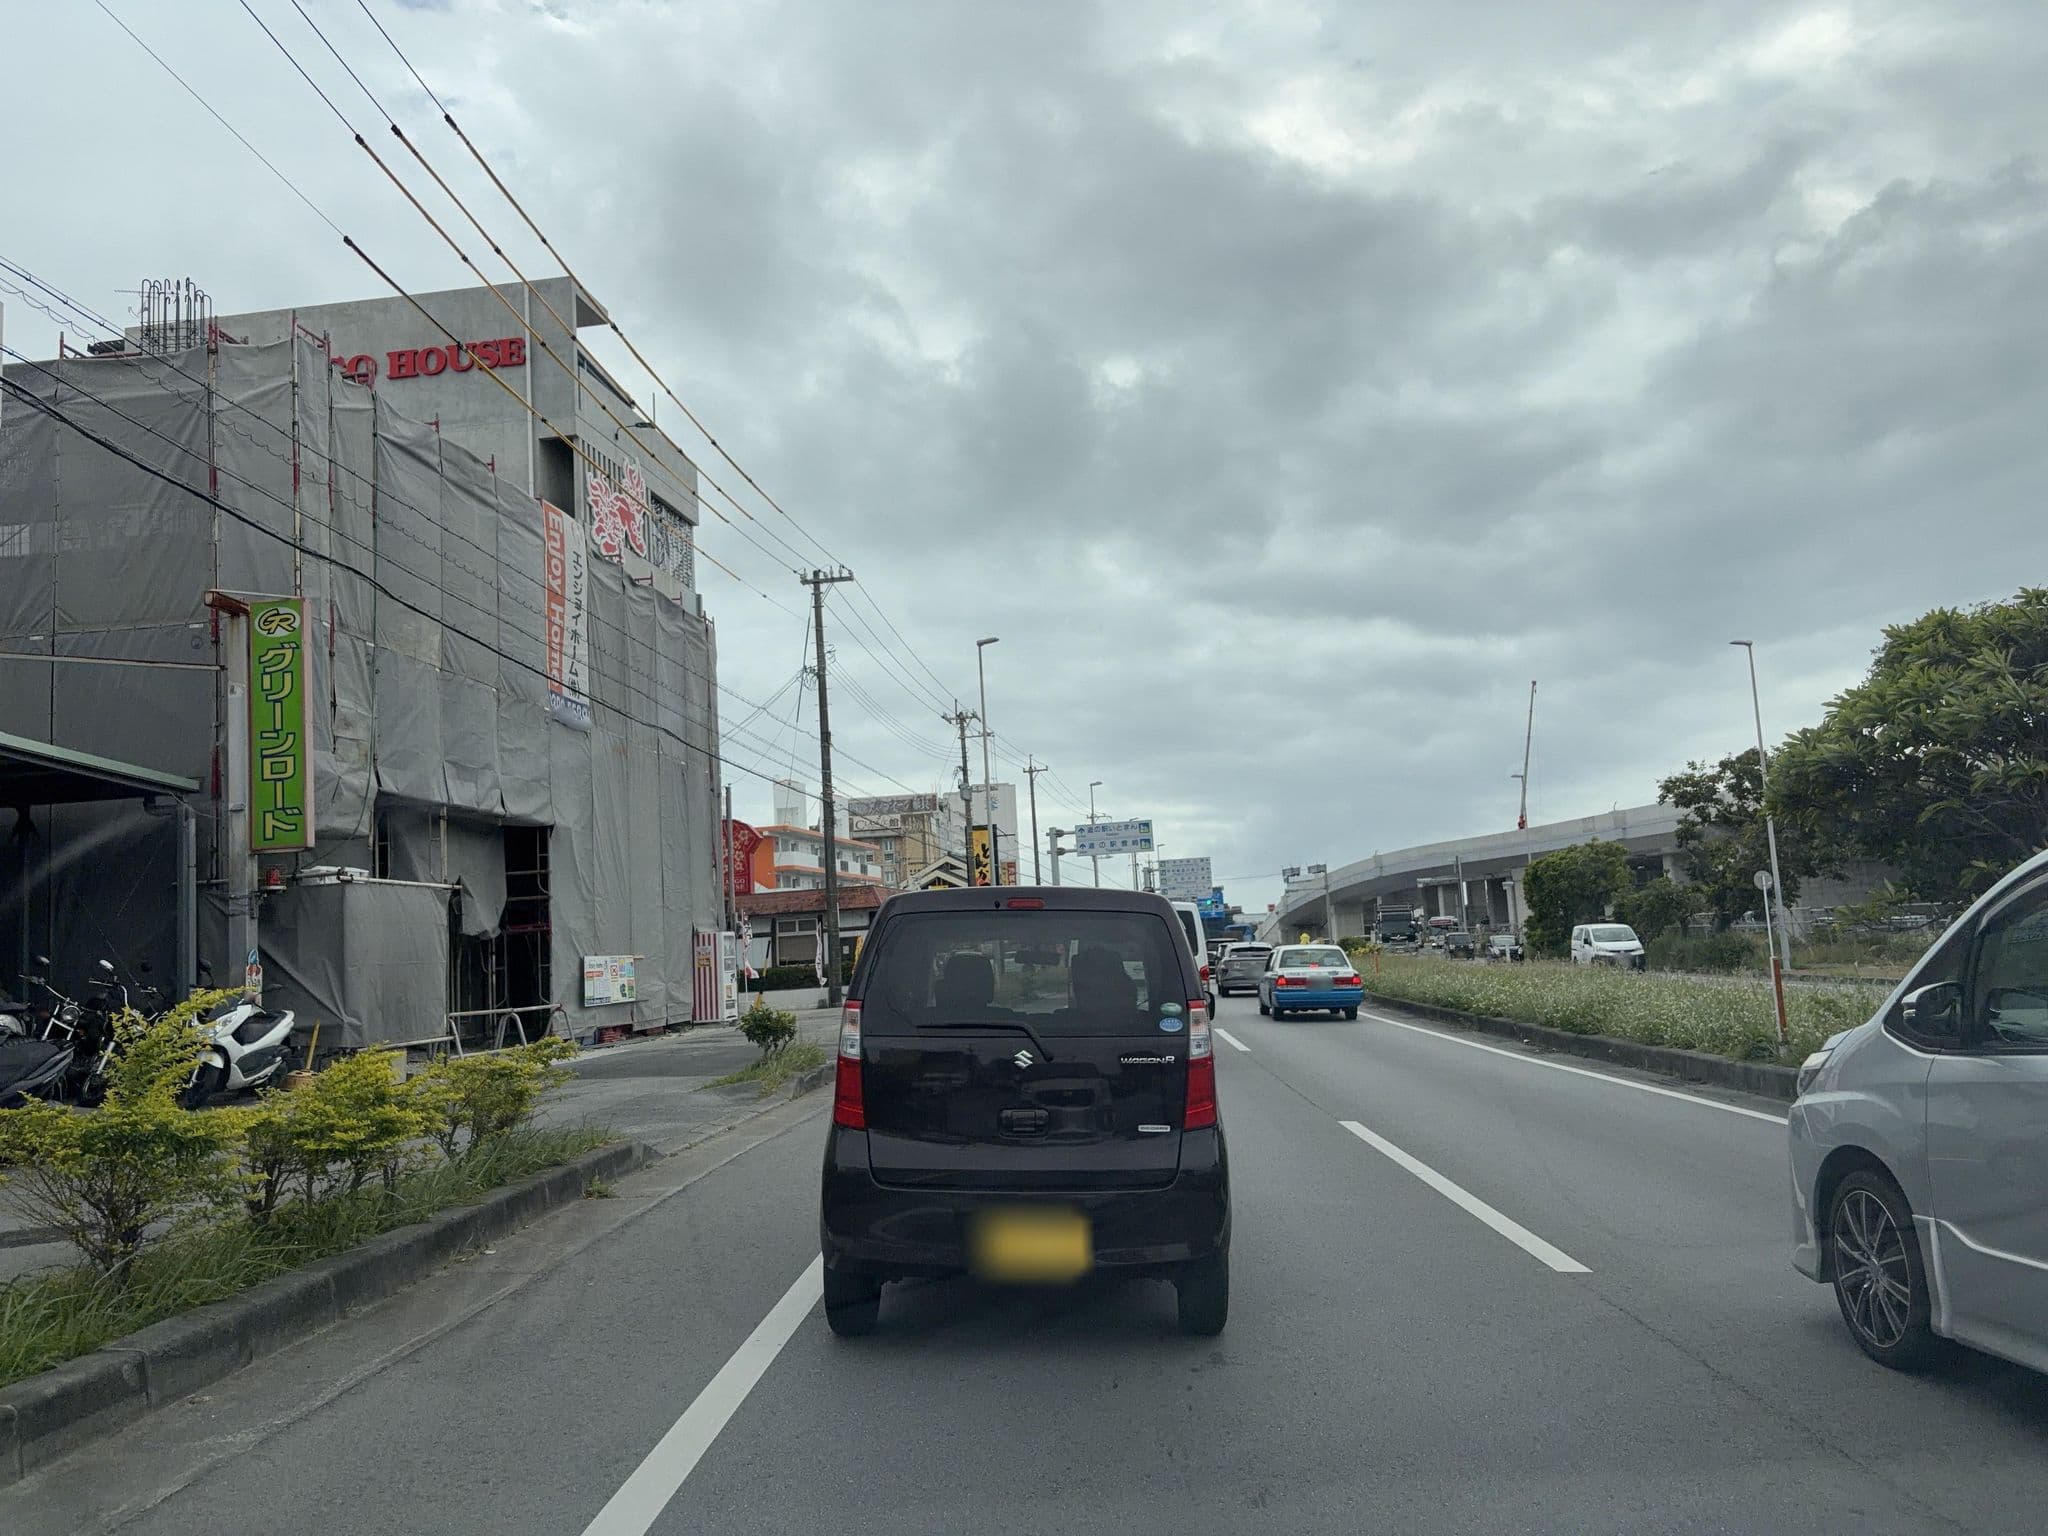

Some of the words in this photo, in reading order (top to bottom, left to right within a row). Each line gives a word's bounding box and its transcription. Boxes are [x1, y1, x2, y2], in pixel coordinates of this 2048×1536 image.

[386, 337, 526, 379] HOUSE
[548, 510, 564, 595] Enjoy
[549, 602, 563, 687] Home
[259, 641, 303, 841] グリーンロード
